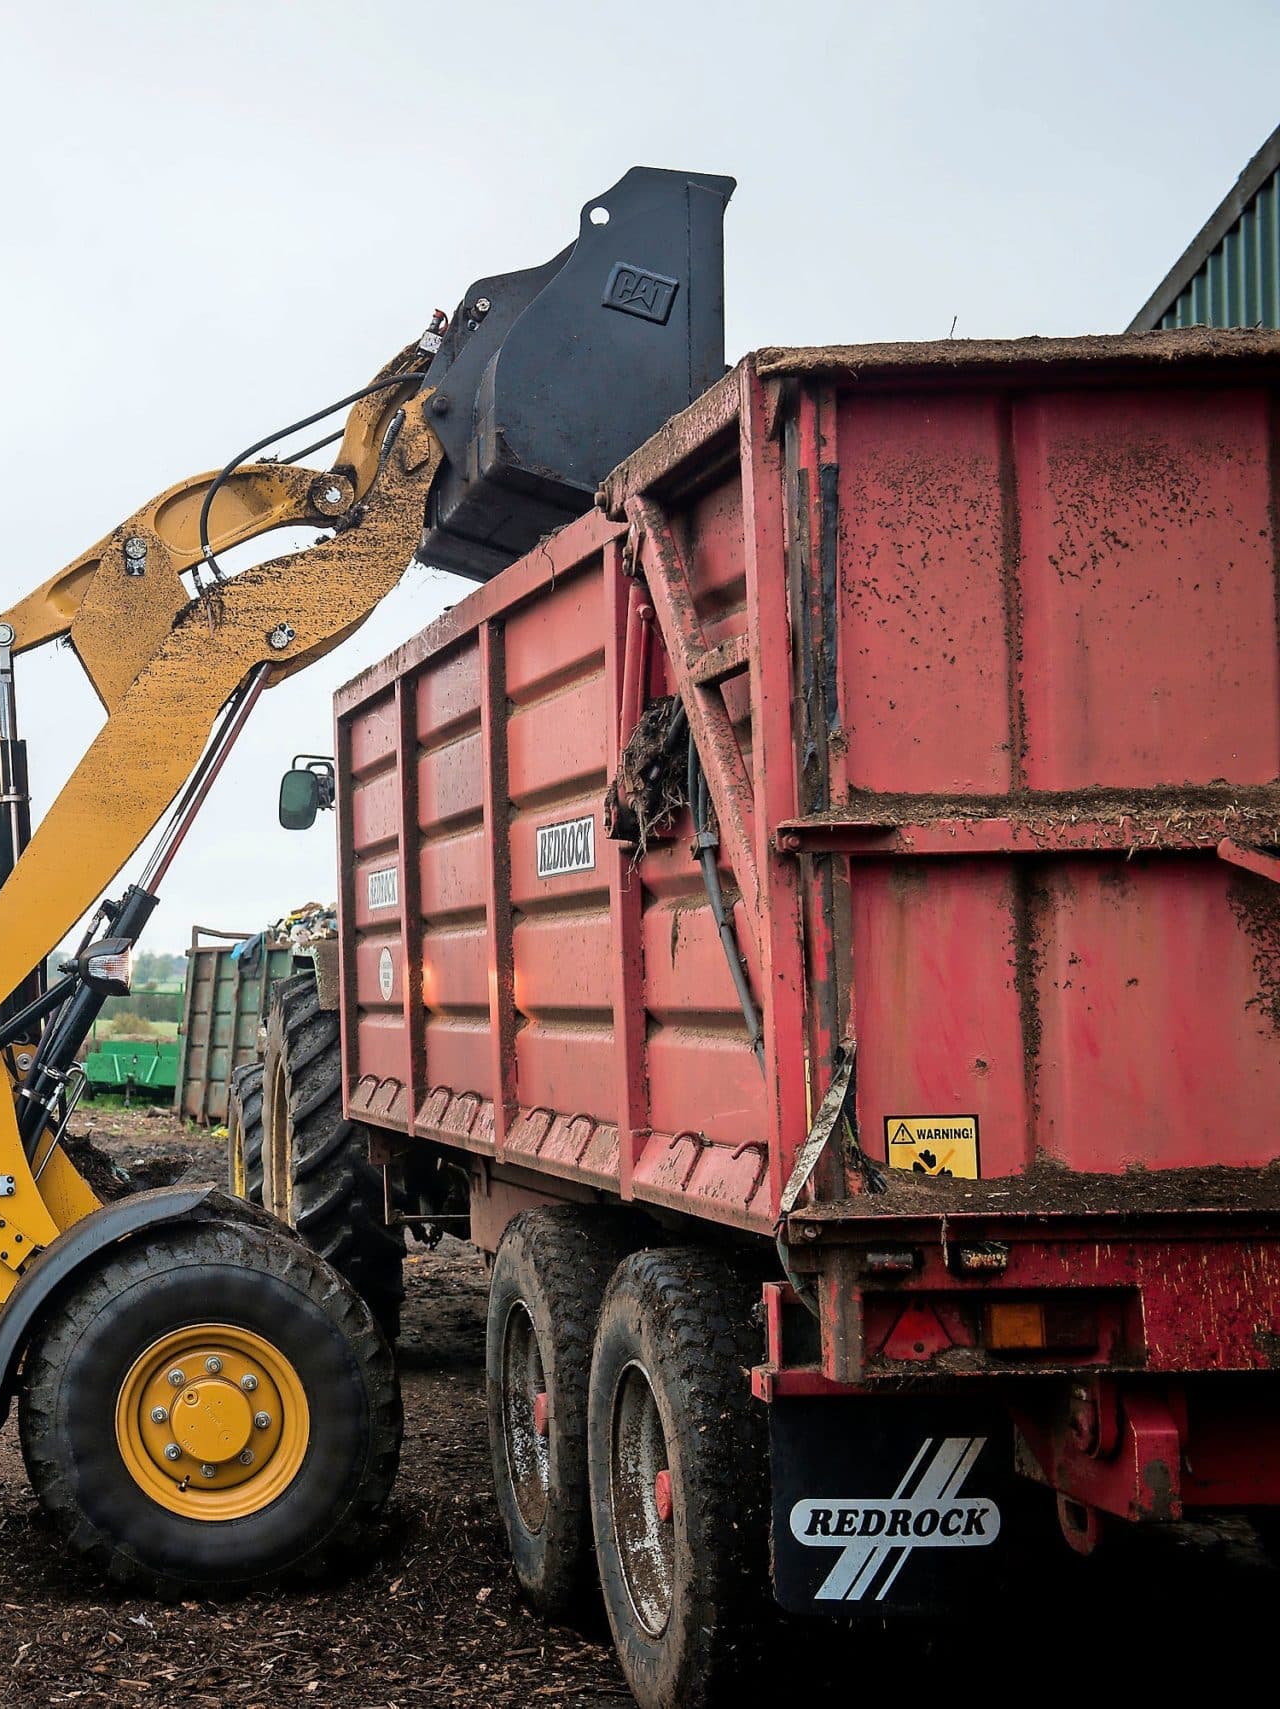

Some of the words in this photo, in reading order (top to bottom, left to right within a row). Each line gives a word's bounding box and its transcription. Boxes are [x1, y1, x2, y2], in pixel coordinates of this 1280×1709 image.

[611, 269, 674, 316] CAT
[539, 821, 592, 873] REDROCK
[916, 1127, 973, 1140] WARNING!
[804, 1508, 990, 1537] REDROCK
